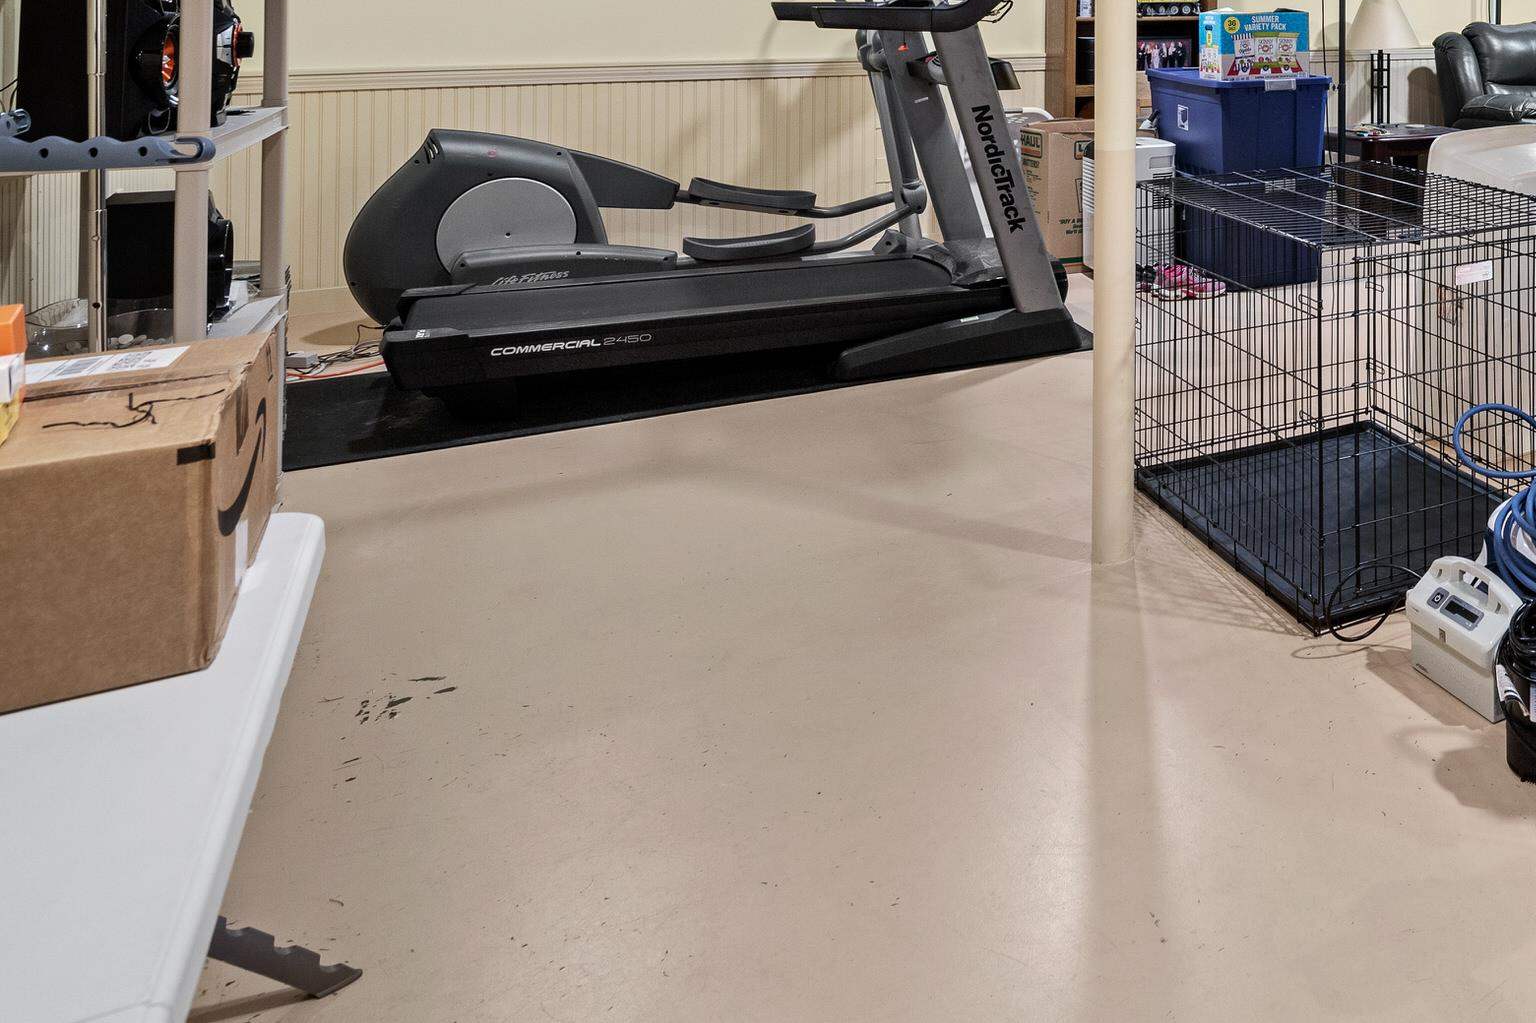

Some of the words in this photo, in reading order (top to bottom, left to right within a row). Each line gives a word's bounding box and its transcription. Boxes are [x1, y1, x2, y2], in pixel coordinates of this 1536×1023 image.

[1227, 19, 1237, 27] 36
[1251, 15, 1280, 23] SUMMER
[1244, 23, 1269, 31] VARIETY
[1270, 23, 1287, 31] PACK
[1020, 134, 1041, 148] HAUL
[971, 104, 1026, 234] NordicTrack
[519, 270, 570, 284] Fitness
[490, 339, 602, 357] COMMERCIAL
[603, 333, 653, 346] 2450
